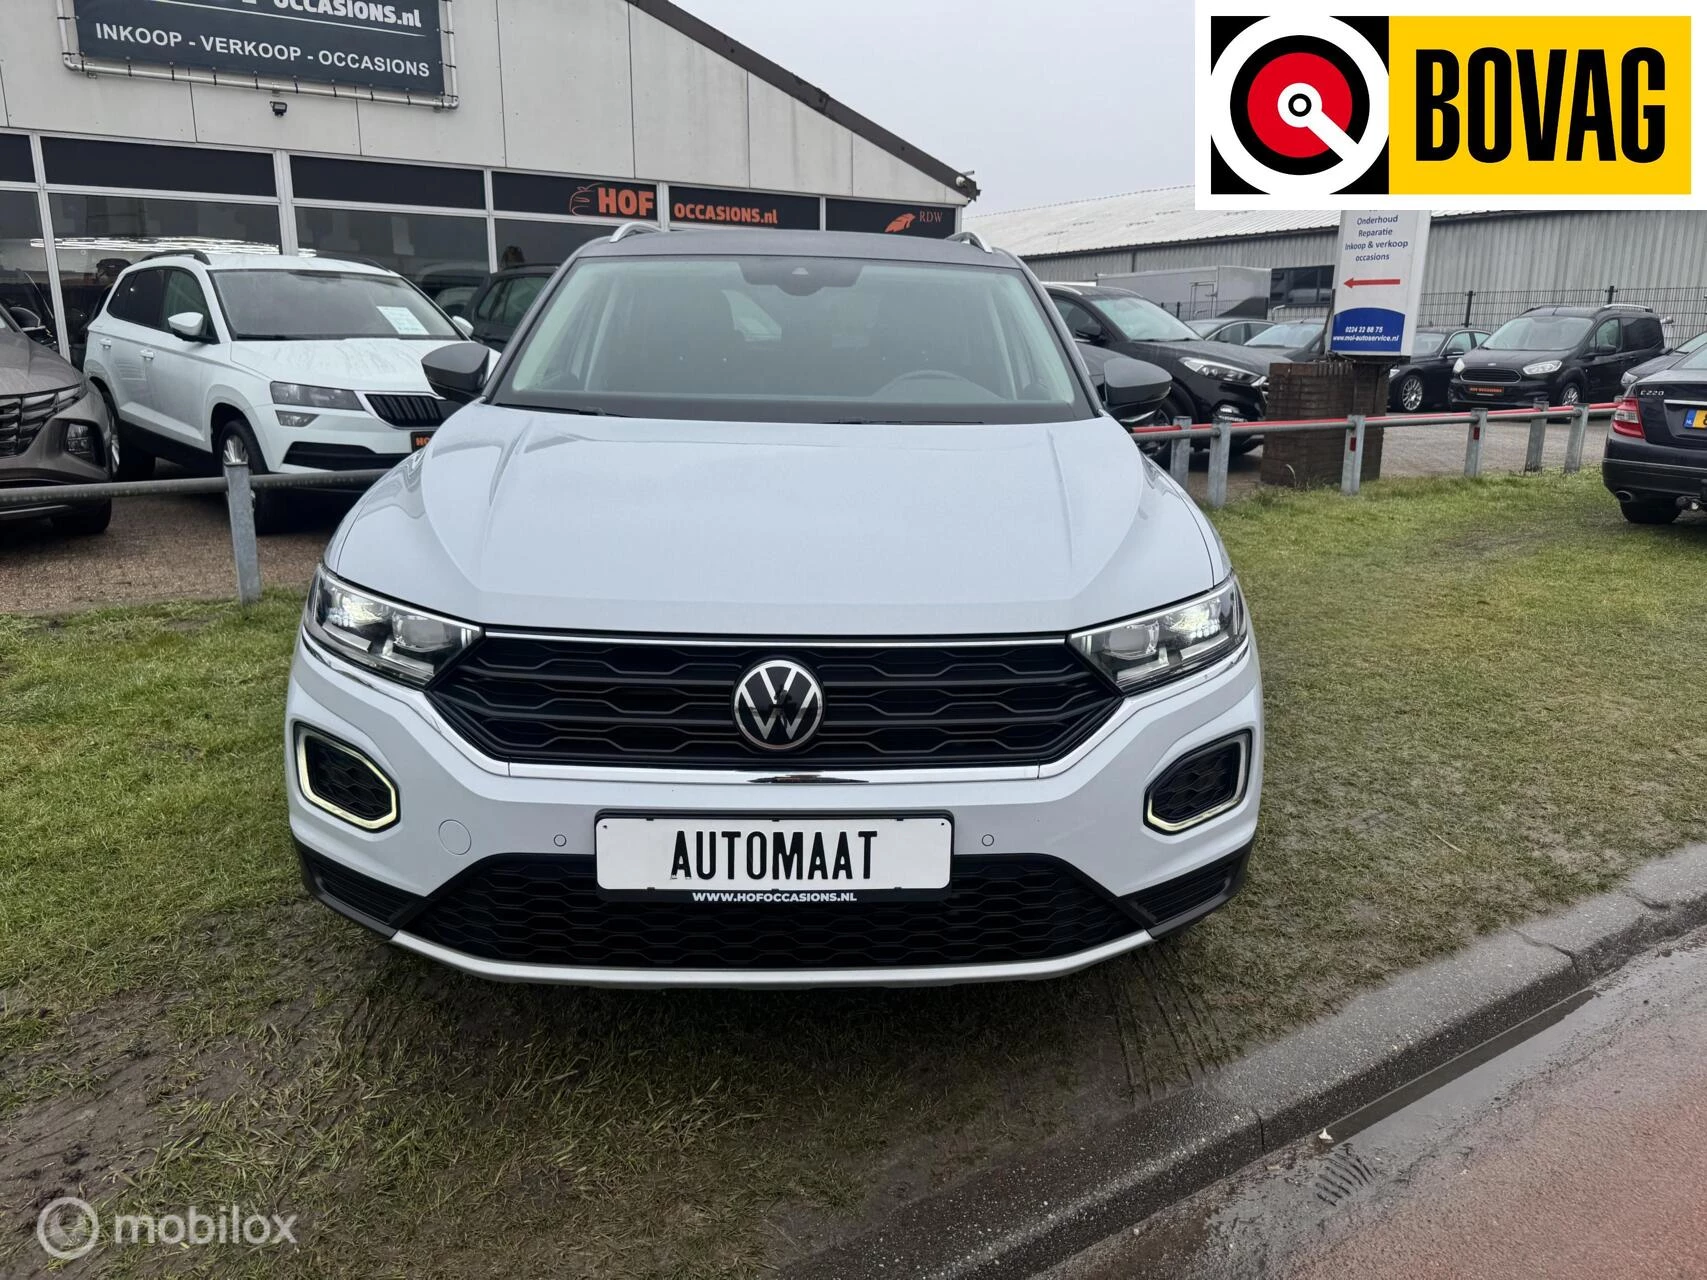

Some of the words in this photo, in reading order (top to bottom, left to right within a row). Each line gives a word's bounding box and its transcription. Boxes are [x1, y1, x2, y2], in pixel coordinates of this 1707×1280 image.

[95, 23, 182, 47] INKOOP
[200, 35, 301, 61] VERKOOP
[318, 50, 430, 77] OCCASIONS
[598, 187, 654, 216] HOF
[674, 202, 778, 224] OCCASIONS.nl
[920, 211, 943, 223] RDW
[1357, 215, 1398, 225] Onderhoud
[1358, 228, 1393, 238] Reparatie
[1345, 242, 1366, 251] Inkoop
[1367, 241, 1374, 249] &
[1376, 240, 1409, 249] verkoop
[1355, 253, 1390, 262] occasions
[671, 830, 878, 880] AUTOMAAT
[692, 892, 857, 902] WWW.HOFOCCASIONS.NL
